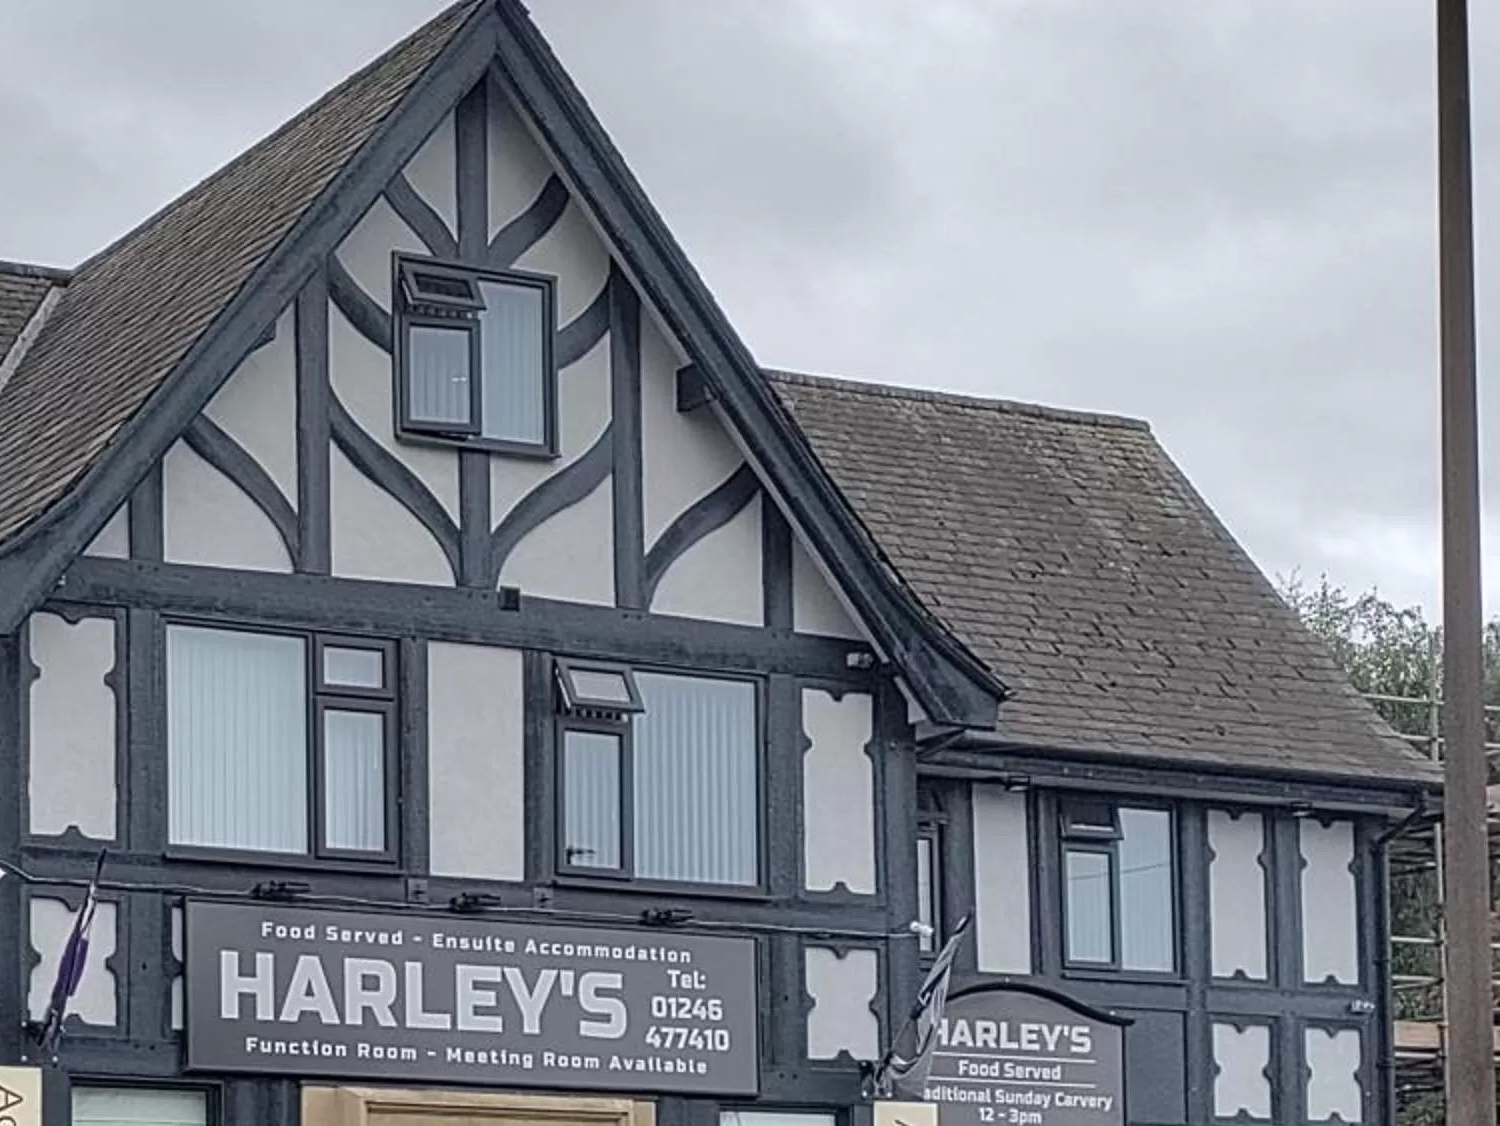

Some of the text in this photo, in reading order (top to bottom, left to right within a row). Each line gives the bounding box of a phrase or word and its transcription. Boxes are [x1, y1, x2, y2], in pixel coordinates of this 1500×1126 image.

[261, 921, 315, 939] Food
[325, 926, 403, 945] Served
[432, 933, 516, 953] Ensuite
[525, 938, 691, 963] Accommodation
[667, 968, 706, 989] Tel:
[219, 949, 628, 1040] HARLEY'S
[651, 996, 723, 1020] 01246
[645, 1025, 730, 1051] 477410
[245, 1037, 347, 1057] Function
[357, 1043, 417, 1060] Room
[446, 1047, 533, 1068] Meeting
[543, 1051, 599, 1069] Room
[609, 1056, 707, 1074] Available
[958, 1059, 1061, 1080] Food Served
[923, 1085, 1112, 1112] aditional Sunday Carvery
[979, 1107, 994, 1122] 12
[1008, 1108, 1042, 1126] 3pm
